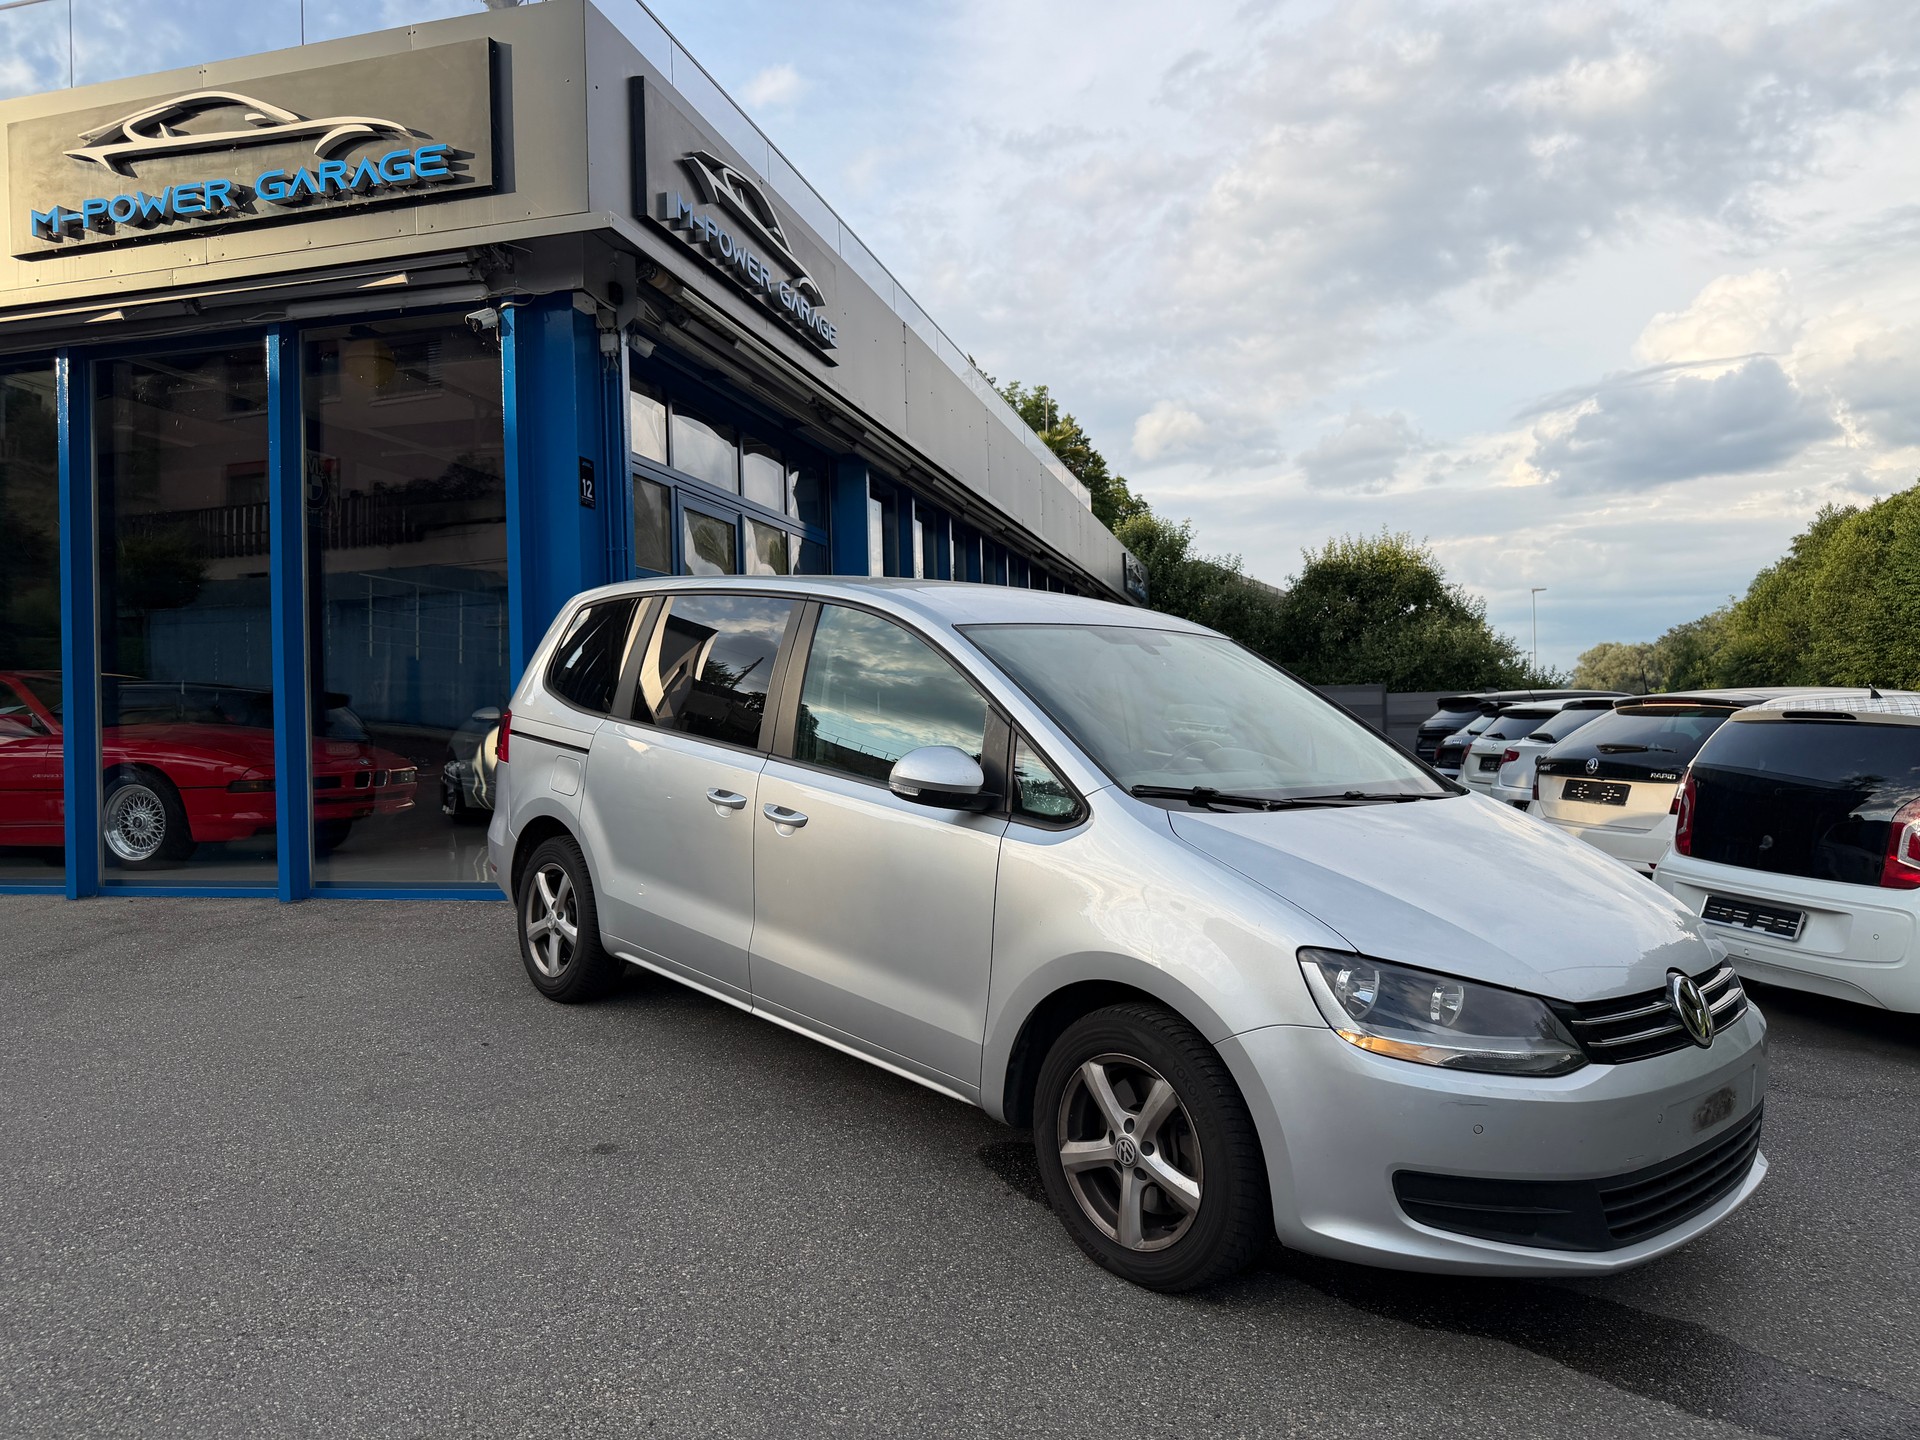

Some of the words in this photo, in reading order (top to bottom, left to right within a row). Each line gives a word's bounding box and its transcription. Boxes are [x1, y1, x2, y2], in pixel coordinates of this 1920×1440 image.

[31, 178, 231, 236] M-POWER
[255, 144, 447, 200] GARAGE
[677, 191, 772, 294] M-POWER
[779, 280, 838, 348] GARAGE
[582, 478, 593, 498] 12
[1650, 772, 1677, 780] RAPID
